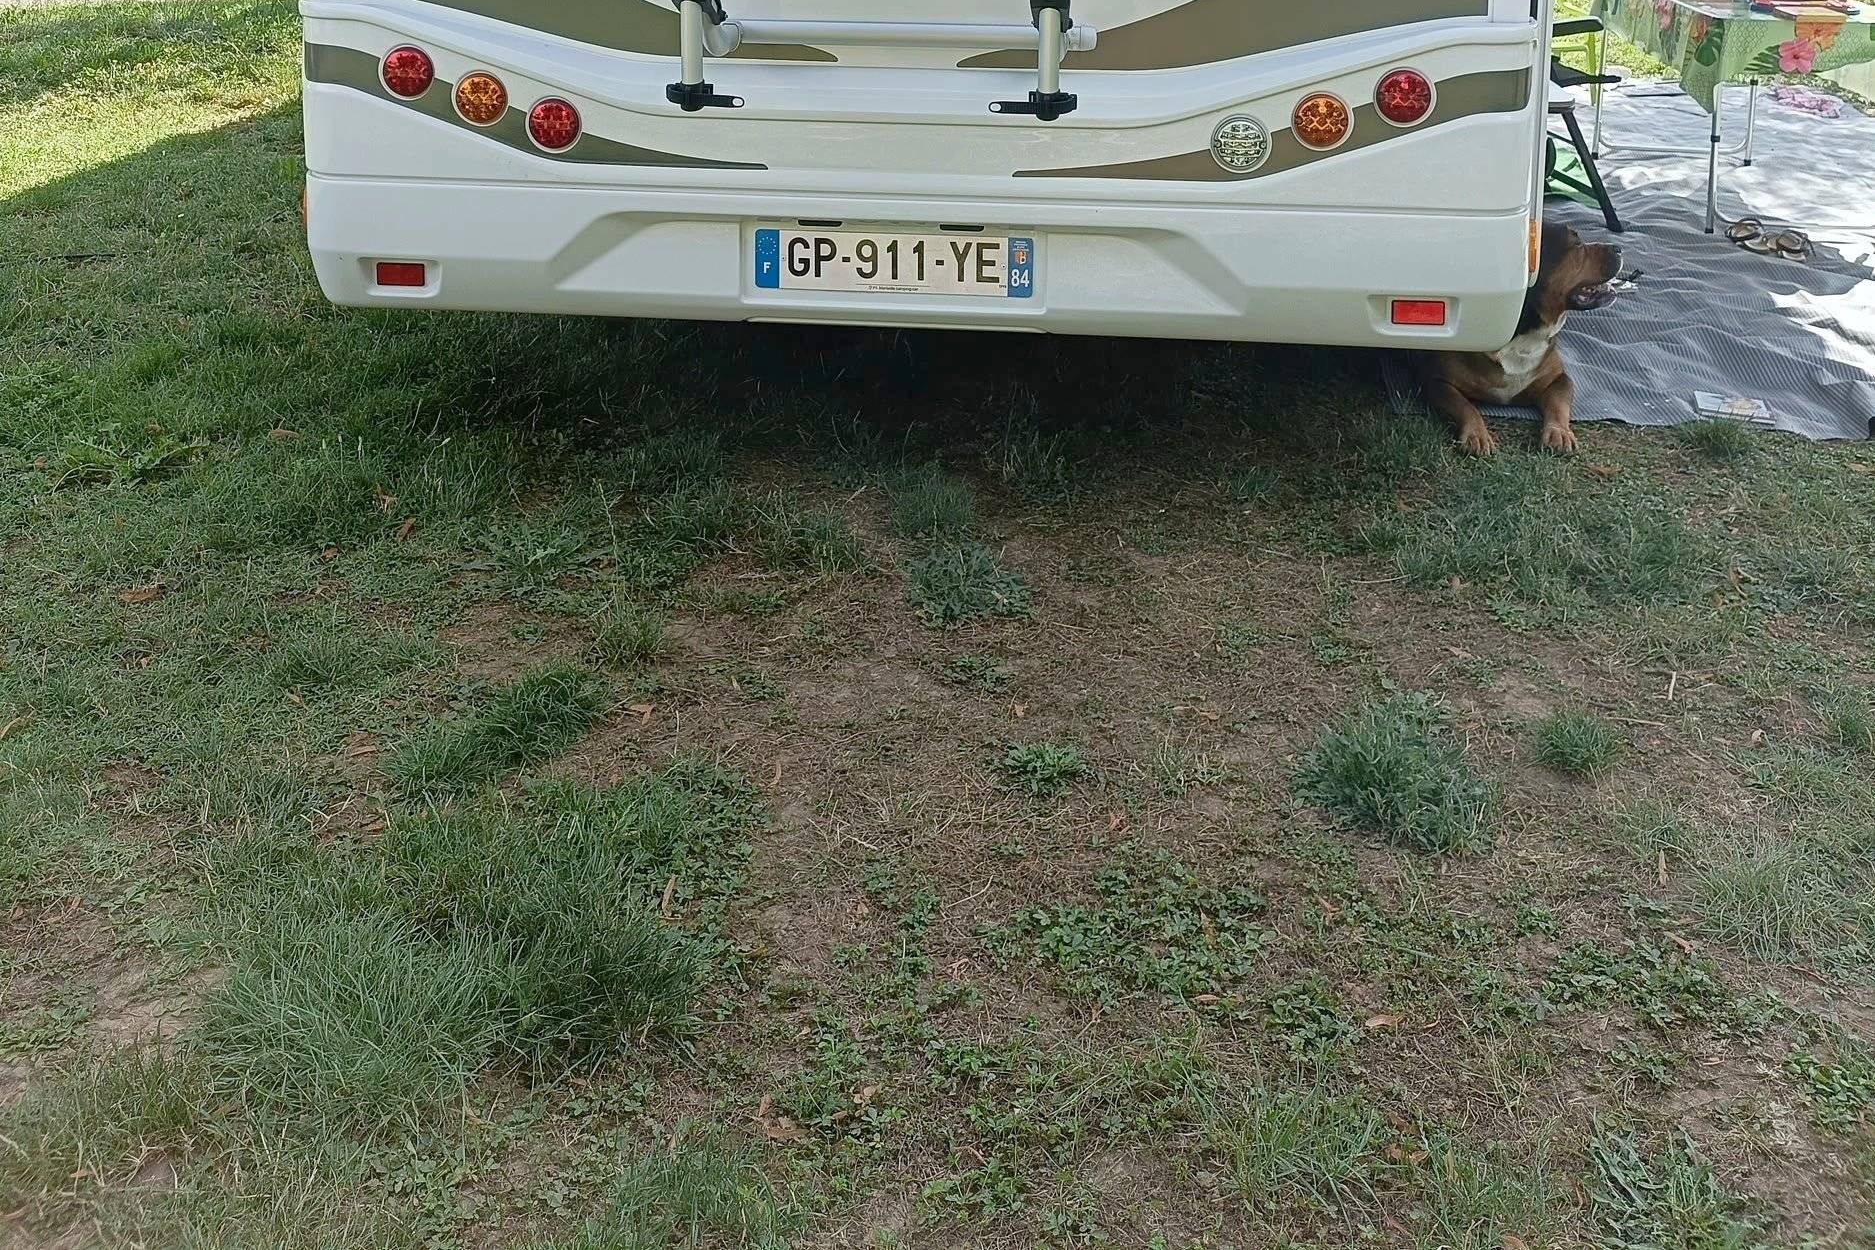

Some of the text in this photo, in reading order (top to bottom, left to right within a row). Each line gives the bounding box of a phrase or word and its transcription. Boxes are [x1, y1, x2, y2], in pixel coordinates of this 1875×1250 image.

[763, 262, 771, 274] F
[787, 236, 1001, 284] GP-911-YE
[1011, 268, 1030, 288] 84
